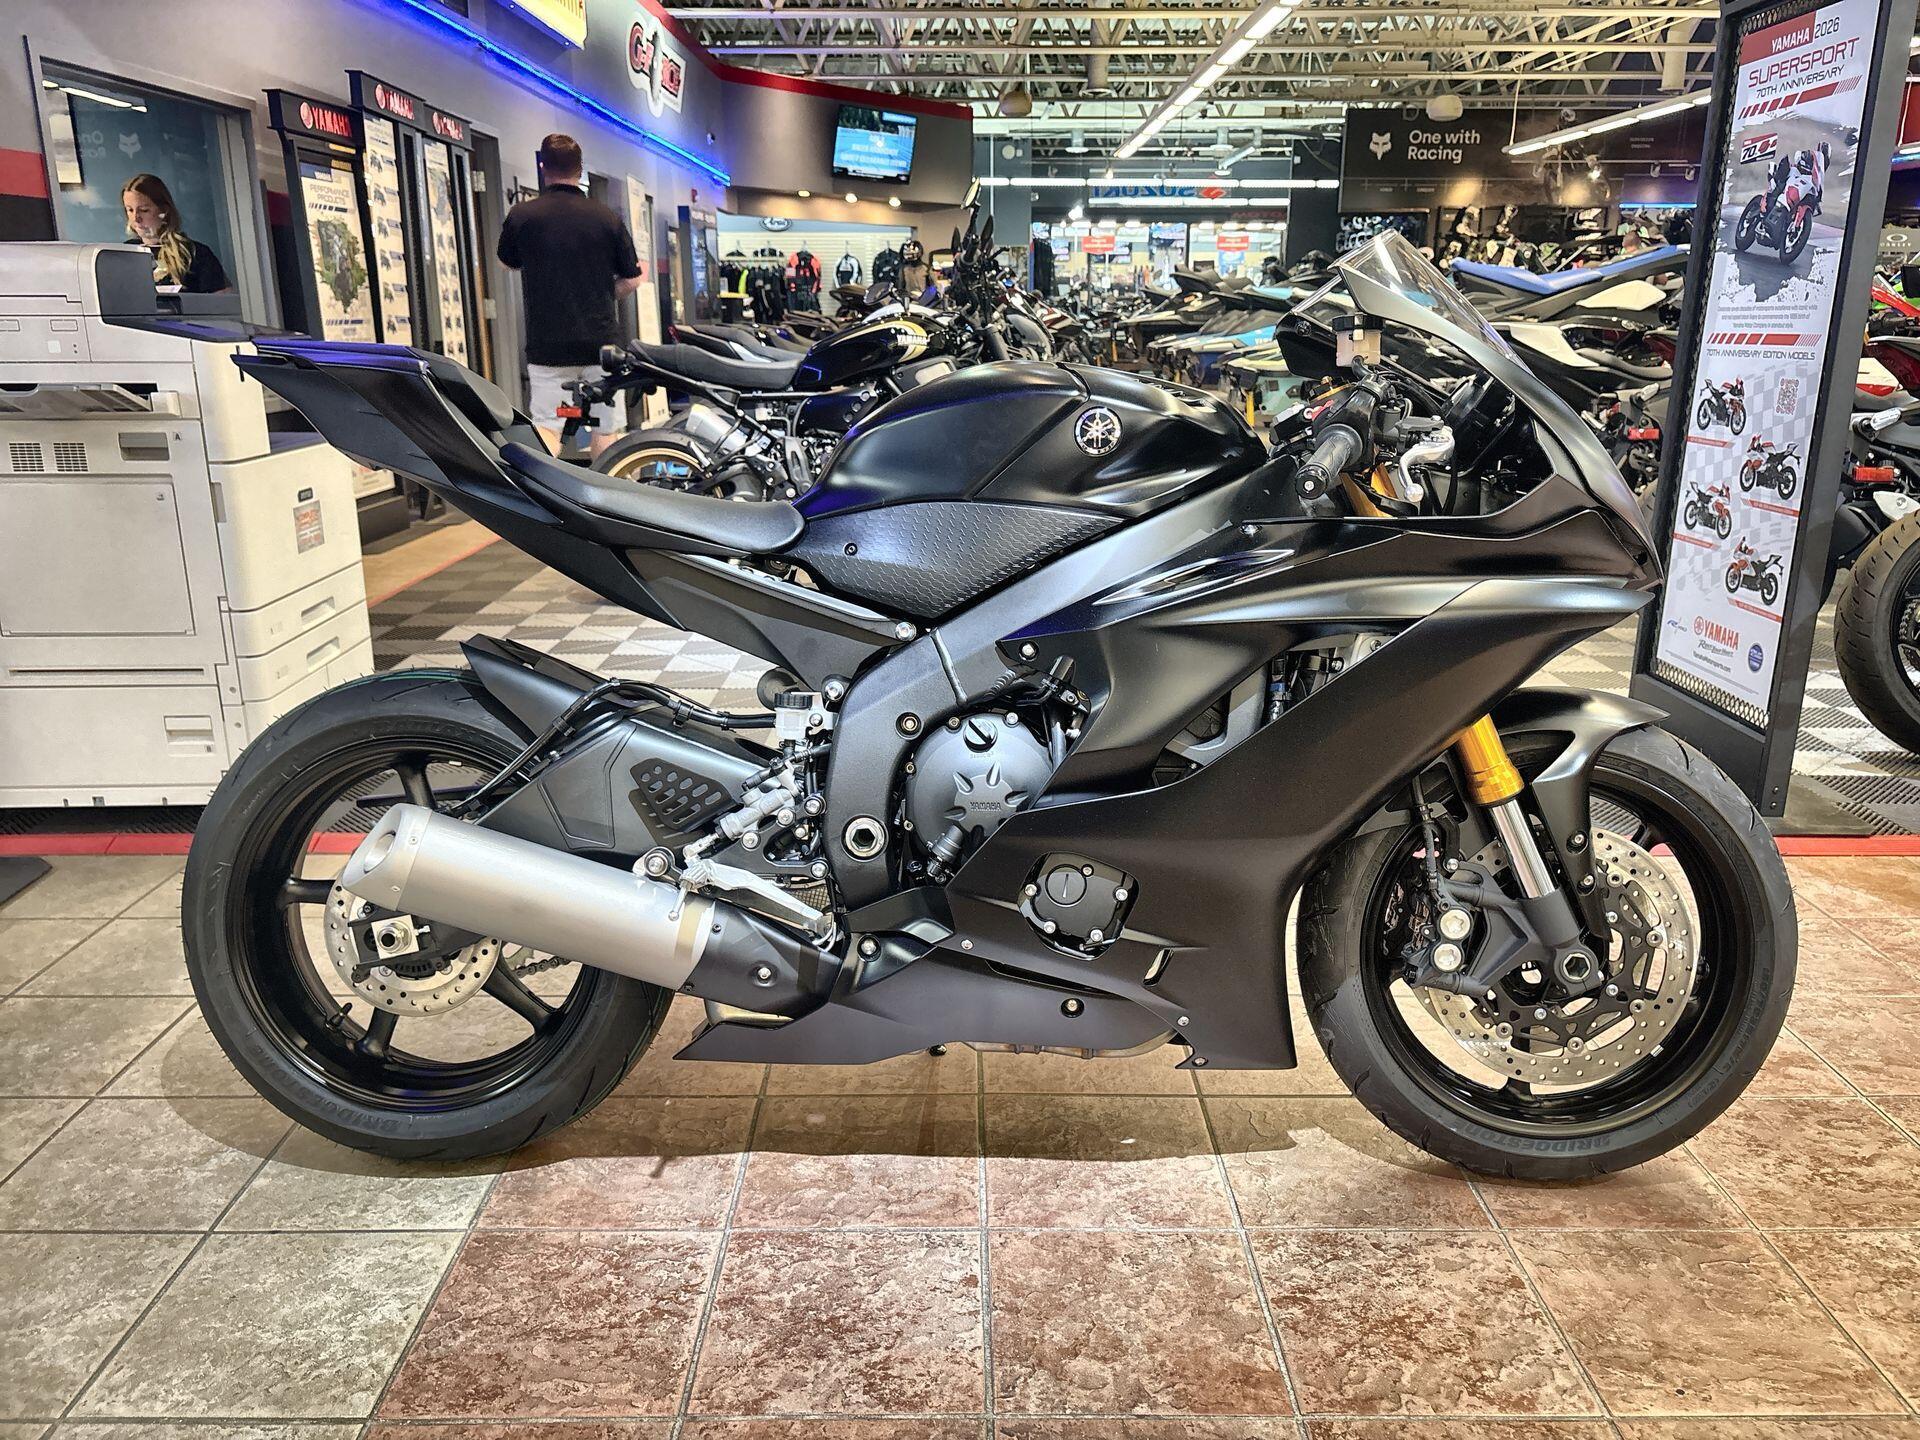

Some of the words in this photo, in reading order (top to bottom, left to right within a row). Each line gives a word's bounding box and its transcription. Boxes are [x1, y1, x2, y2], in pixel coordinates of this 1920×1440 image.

[1771, 28, 1810, 53] YAMAHA
[1815, 17, 1840, 39] 2026
[1748, 37, 1860, 88] SUPERSPORT
[1756, 84, 1778, 99] 70TH
[1779, 64, 1845, 93] ANNIVERSARY
[1409, 130, 1441, 144] One
[1445, 129, 1480, 144] with
[1408, 145, 1462, 164] Racing
[896, 334, 928, 346] YAMAHA
[1706, 348, 1721, 357] 70TH
[1721, 349, 1762, 359] ANNIVERSARY
[1762, 350, 1787, 360] EDITION
[1787, 352, 1816, 361] MODELS
[1704, 619, 1740, 651] YAMAHA
[969, 801, 1001, 812] YAMAHA
[1454, 1119, 1611, 1153] BRIDGESTONE
